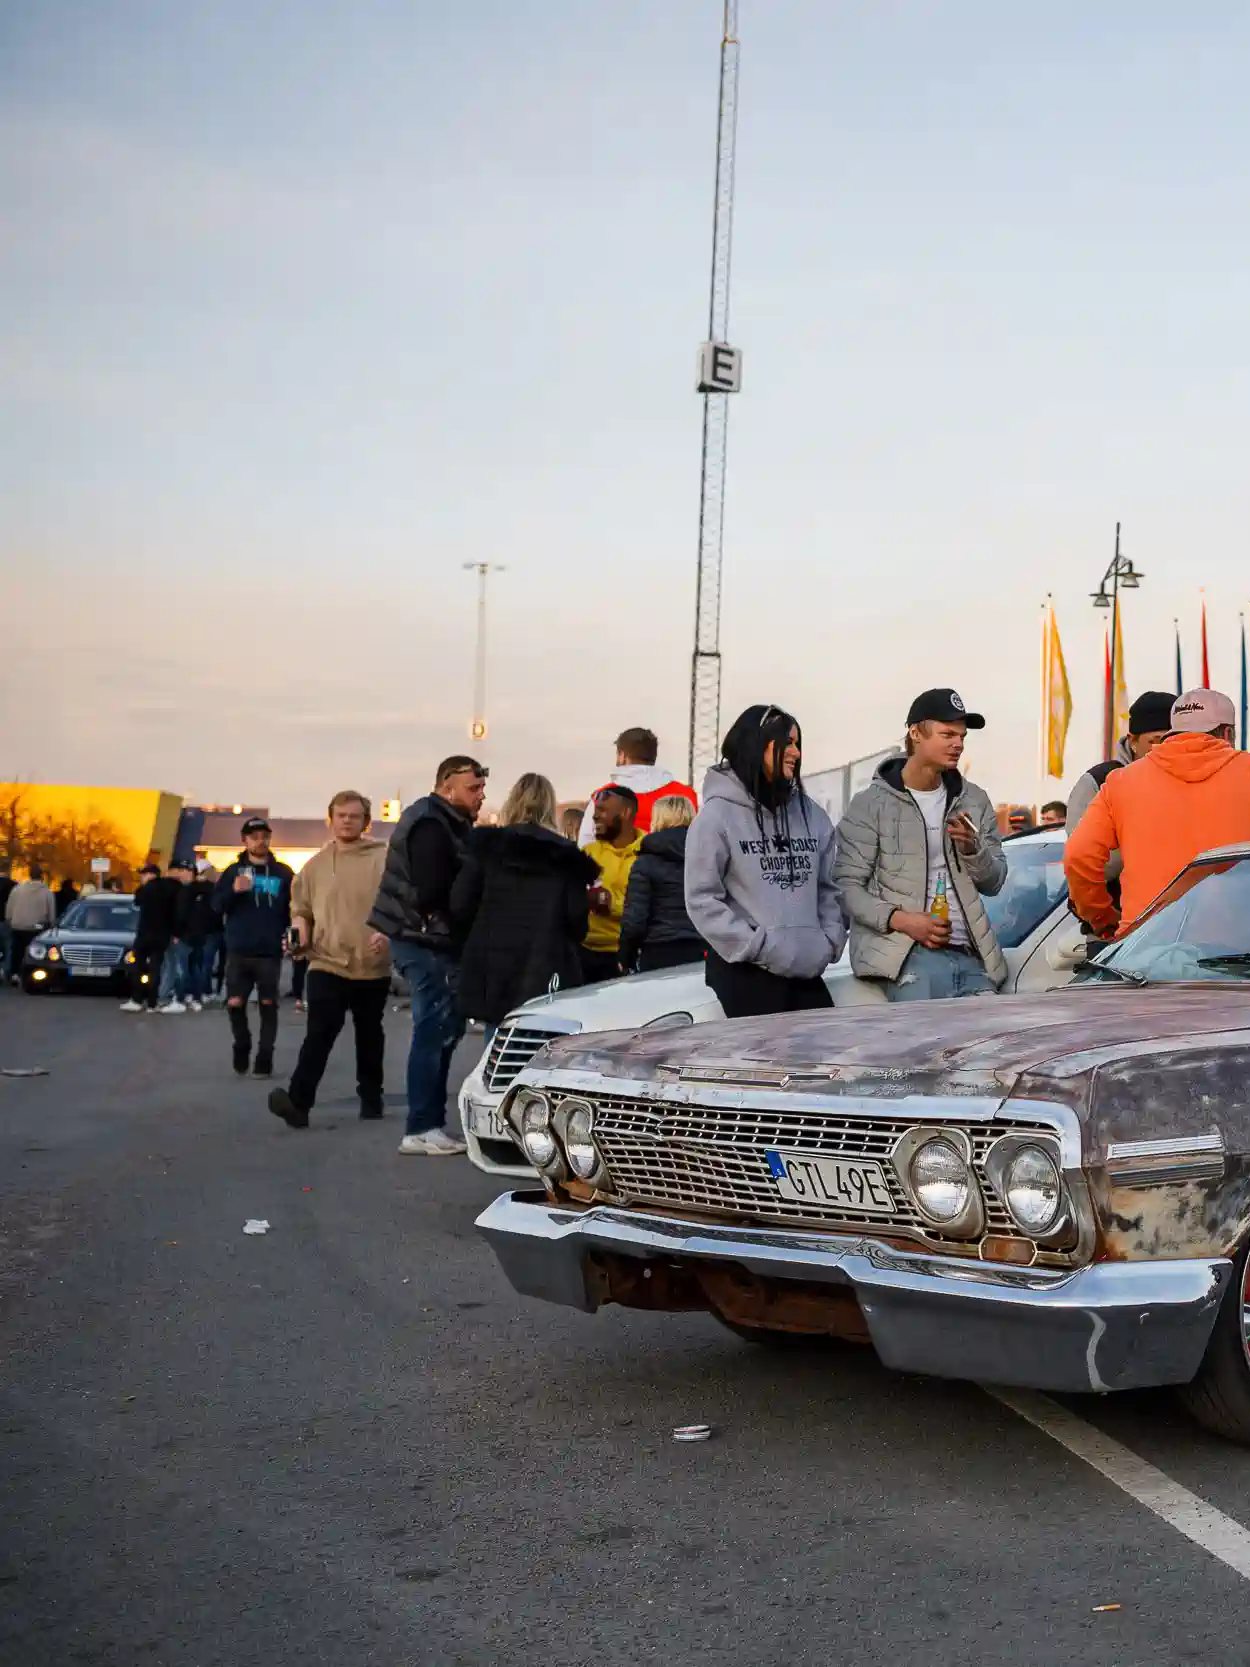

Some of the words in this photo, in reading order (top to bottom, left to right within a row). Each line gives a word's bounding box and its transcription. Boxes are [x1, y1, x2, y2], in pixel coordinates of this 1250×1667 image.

[711, 345, 735, 387] E
[738, 839, 771, 855] WEST
[791, 837, 818, 853] COAST
[785, 1159, 839, 1200] GTL
[835, 1165, 889, 1206] 49E
